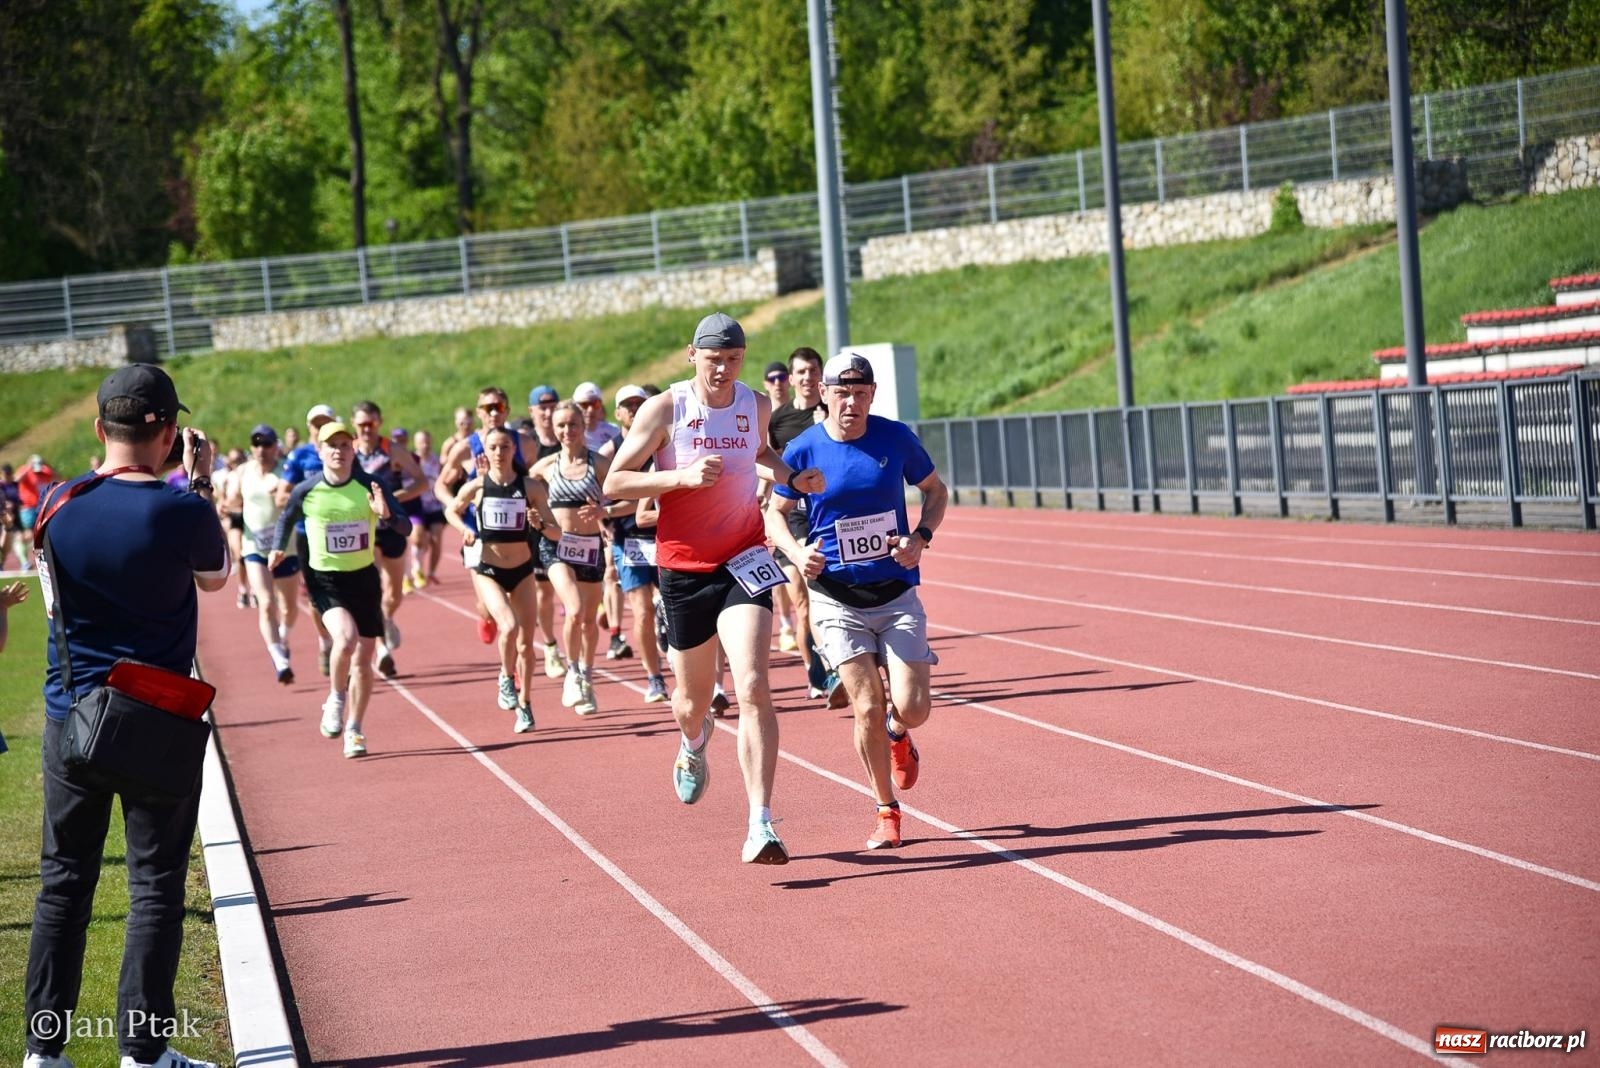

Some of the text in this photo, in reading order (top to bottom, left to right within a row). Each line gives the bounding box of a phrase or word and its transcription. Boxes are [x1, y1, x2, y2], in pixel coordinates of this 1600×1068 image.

[687, 419, 704, 429] 4F
[693, 437, 748, 449] POLSKA
[494, 512, 508, 524] 111
[333, 535, 356, 549] 197
[848, 534, 882, 555] 180
[563, 546, 585, 559] 164
[748, 563, 778, 584] 161
